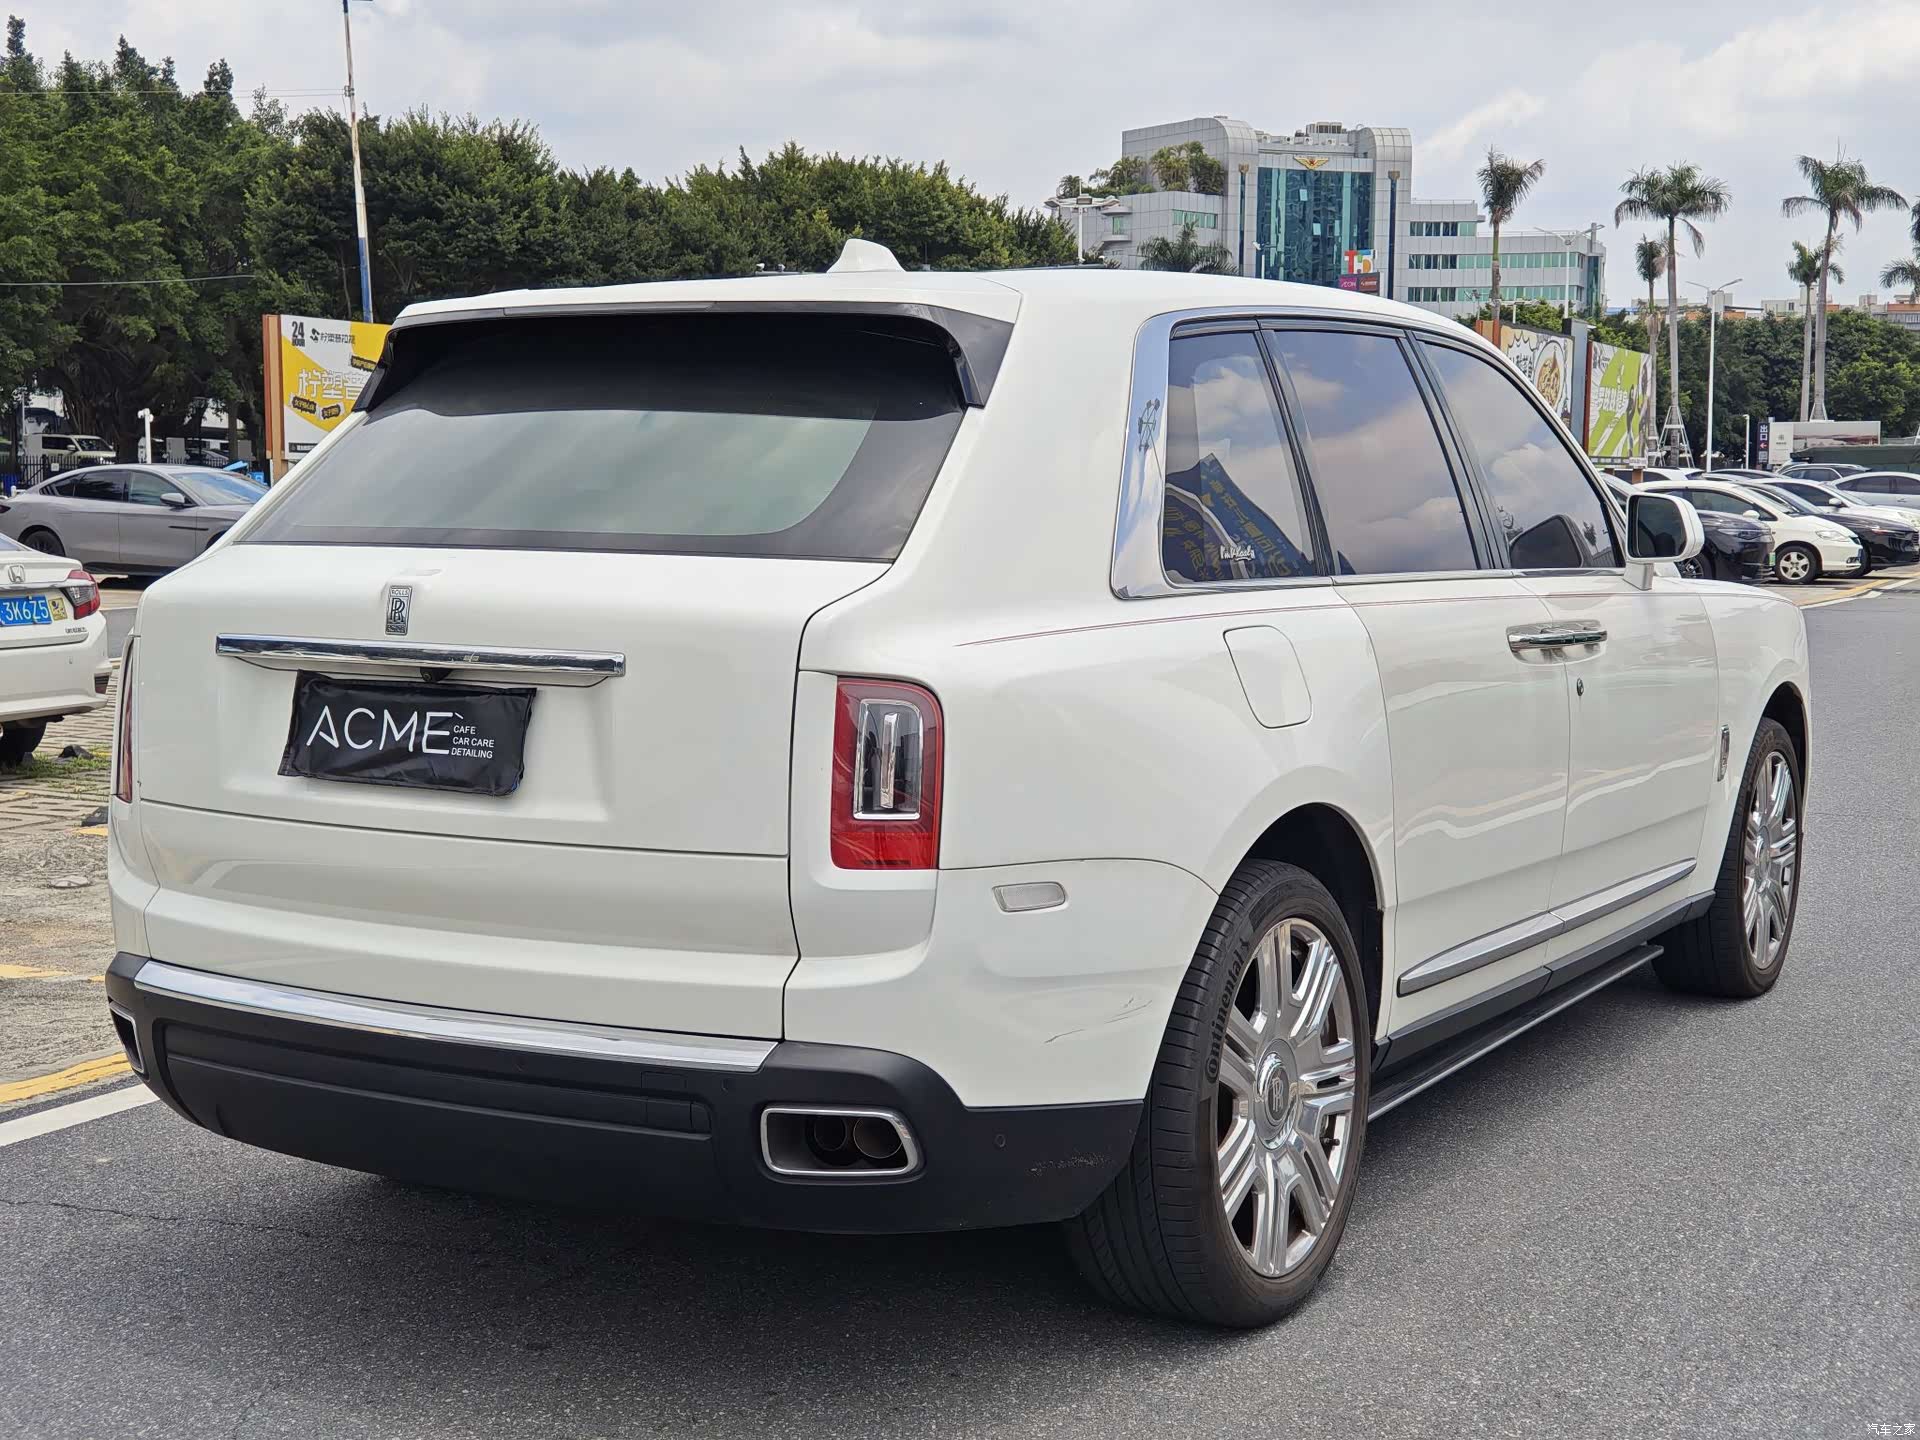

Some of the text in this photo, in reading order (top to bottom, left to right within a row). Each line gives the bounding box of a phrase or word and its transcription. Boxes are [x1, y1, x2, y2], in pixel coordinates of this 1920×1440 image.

[292, 321, 305, 339] 24
[1760, 425, 1768, 441] 出口
[453, 725, 477, 735] CAFE
[452, 736, 495, 748] CAR CARE
[451, 747, 493, 759] DETAILING
